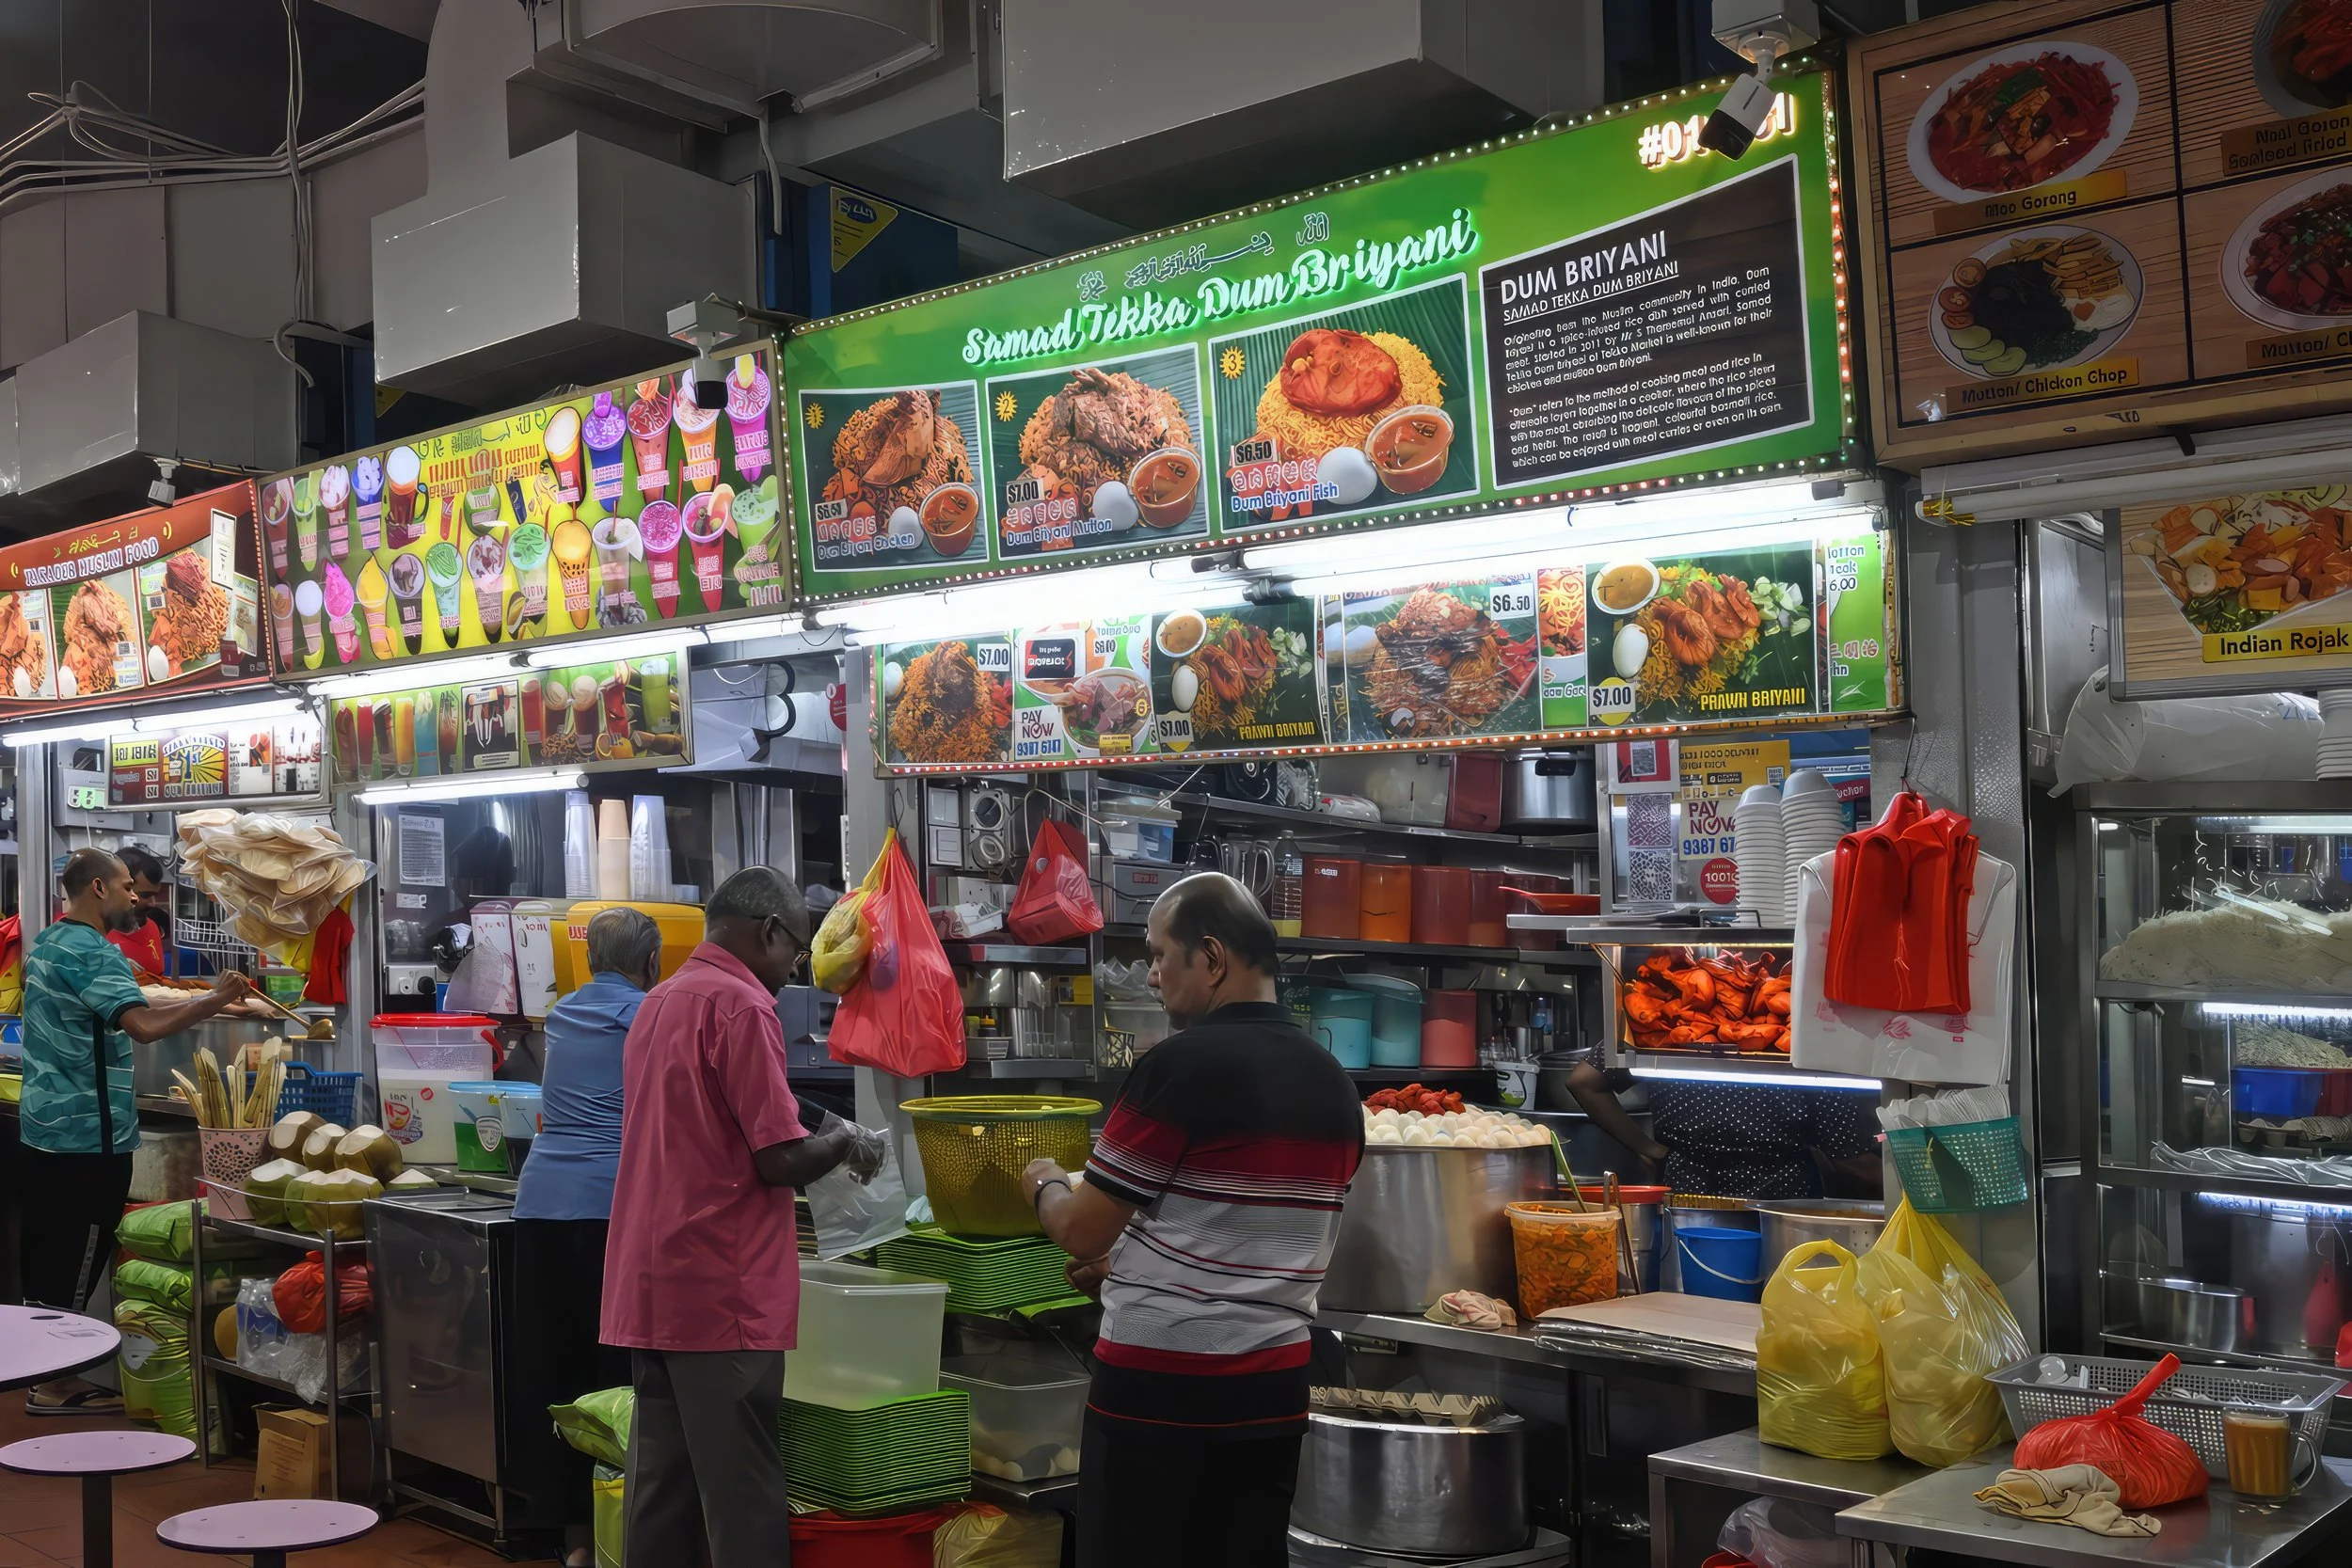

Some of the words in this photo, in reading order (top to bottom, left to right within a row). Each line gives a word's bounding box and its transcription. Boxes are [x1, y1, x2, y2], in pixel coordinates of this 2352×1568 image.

[1501, 266, 1558, 305] DUM
[1565, 230, 1667, 286] BRIYANI
[962, 308, 1083, 366] Samad
[1082, 290, 1200, 344] Tekka
[1197, 275, 1296, 320] Dum
[1292, 207, 1481, 296] Briyani
[1503, 299, 1549, 322] SAMAD
[1551, 288, 1590, 309] TEKKA
[1593, 277, 1624, 298] DUM
[1626, 261, 1679, 289] BRIYANI
[1227, 354, 1238, 372] 3
[1002, 398, 1013, 416] 2
[125, 536, 159, 563] FOOD
[1492, 594, 1532, 613] $6.50
[979, 647, 1009, 666] $7.00
[1592, 686, 1632, 707] $7.00
[1021, 709, 1042, 724] PAY
[1022, 722, 1055, 739] NOW
[1688, 800, 1720, 817] PAY
[1683, 837, 1716, 856] 9387
